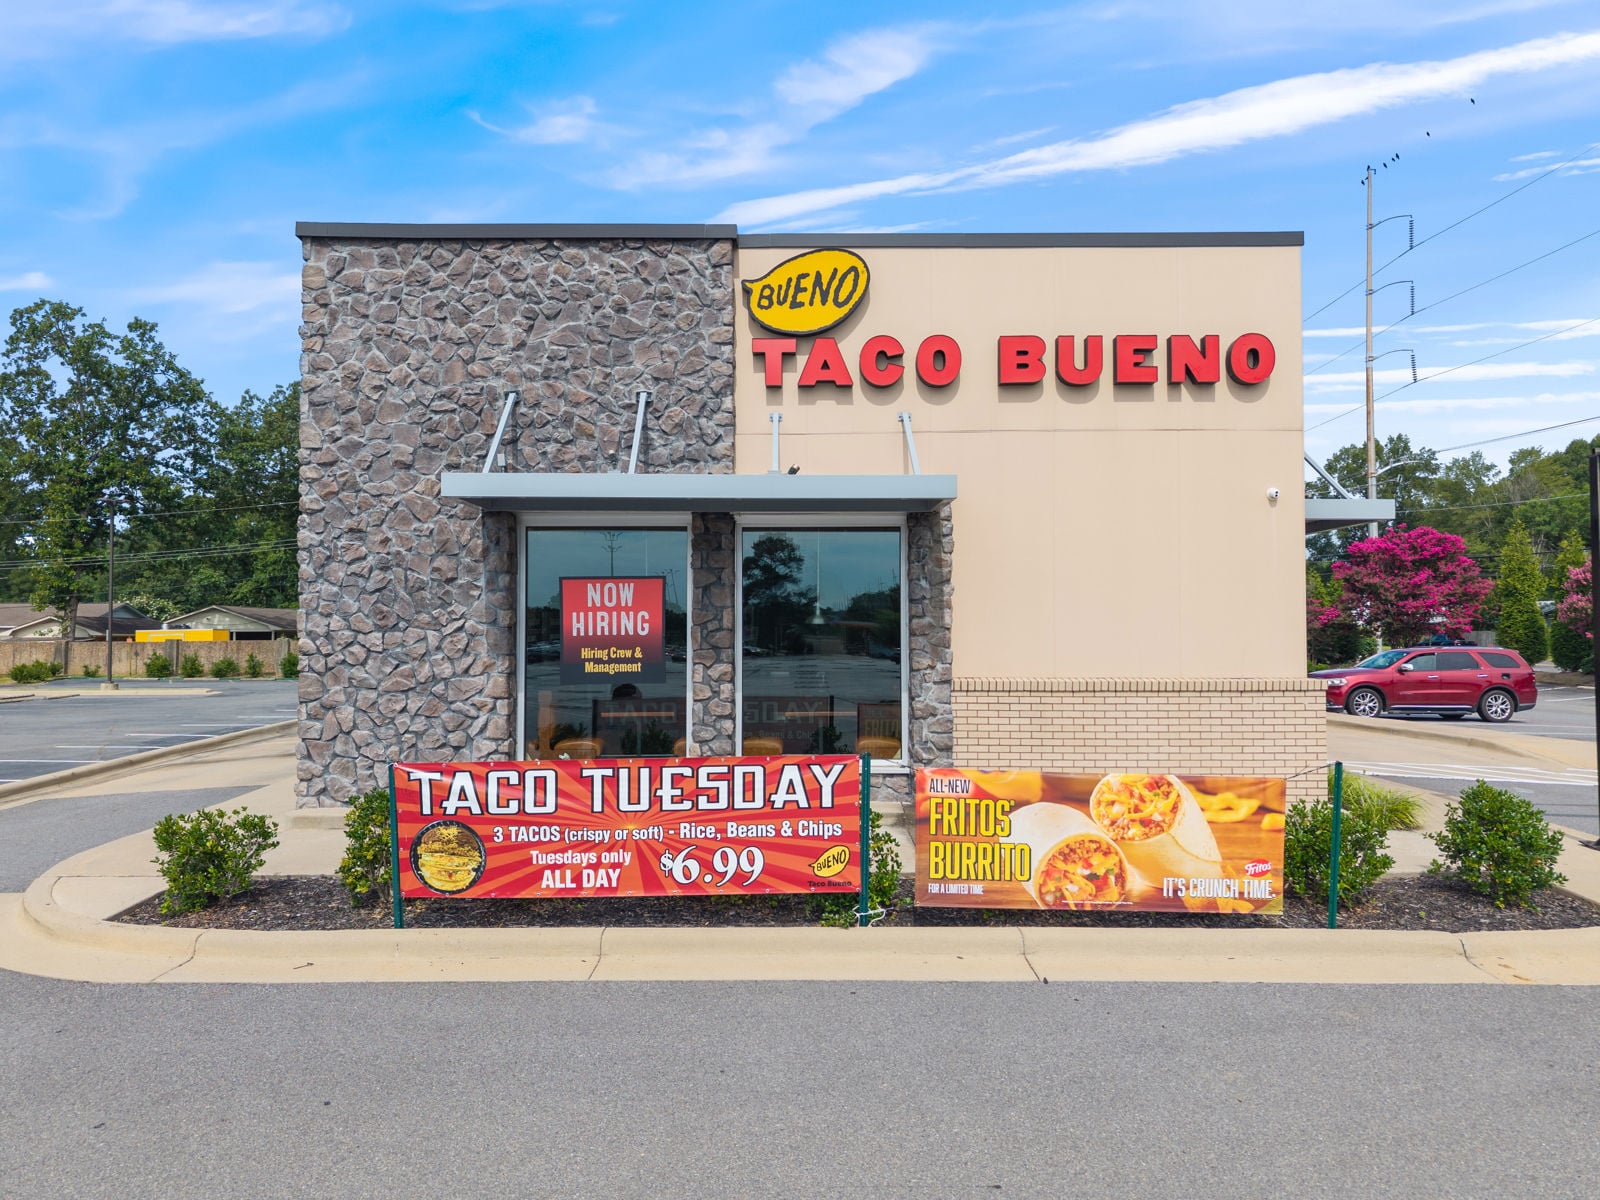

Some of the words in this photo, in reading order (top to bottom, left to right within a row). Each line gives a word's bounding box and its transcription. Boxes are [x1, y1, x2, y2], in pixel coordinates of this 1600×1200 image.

[757, 266, 859, 310] BUENO
[752, 334, 962, 389] TACO
[998, 332, 1276, 388] BUENO
[587, 582, 634, 607] NOW
[572, 611, 649, 636] HIRING
[581, 647, 608, 660] Hiring
[609, 647, 632, 659] Crew
[634, 647, 643, 658] &
[584, 661, 641, 674] Management
[408, 768, 558, 816] TACO
[580, 764, 847, 813] TUESDAY
[929, 778, 970, 794] ALL-NEW
[493, 826, 504, 842] 3
[508, 825, 561, 842] TACOS
[564, 827, 610, 844] (crispy
[614, 829, 628, 840] or
[632, 825, 664, 842] soft)
[679, 822, 721, 840] Rice,
[727, 821, 776, 838] Beans
[780, 820, 793, 837] &
[798, 820, 842, 840] Chips
[530, 850, 597, 867] Tuesdays
[601, 849, 632, 866] only
[660, 845, 764, 887] $6.99
[816, 849, 847, 871] BUENO
[929, 841, 1032, 882] BURRITO
[1244, 861, 1272, 876] Fritos
[541, 869, 576, 888] ALL
[582, 868, 621, 888] DAY
[928, 883, 940, 893] FOR
[940, 884, 946, 893] A
[946, 884, 969, 894] LIMITED
[970, 884, 984, 895] TIME
[1163, 877, 1187, 897] IT'S
[1189, 878, 1239, 898] CRUNCH
[1243, 879, 1277, 899] TIME.
